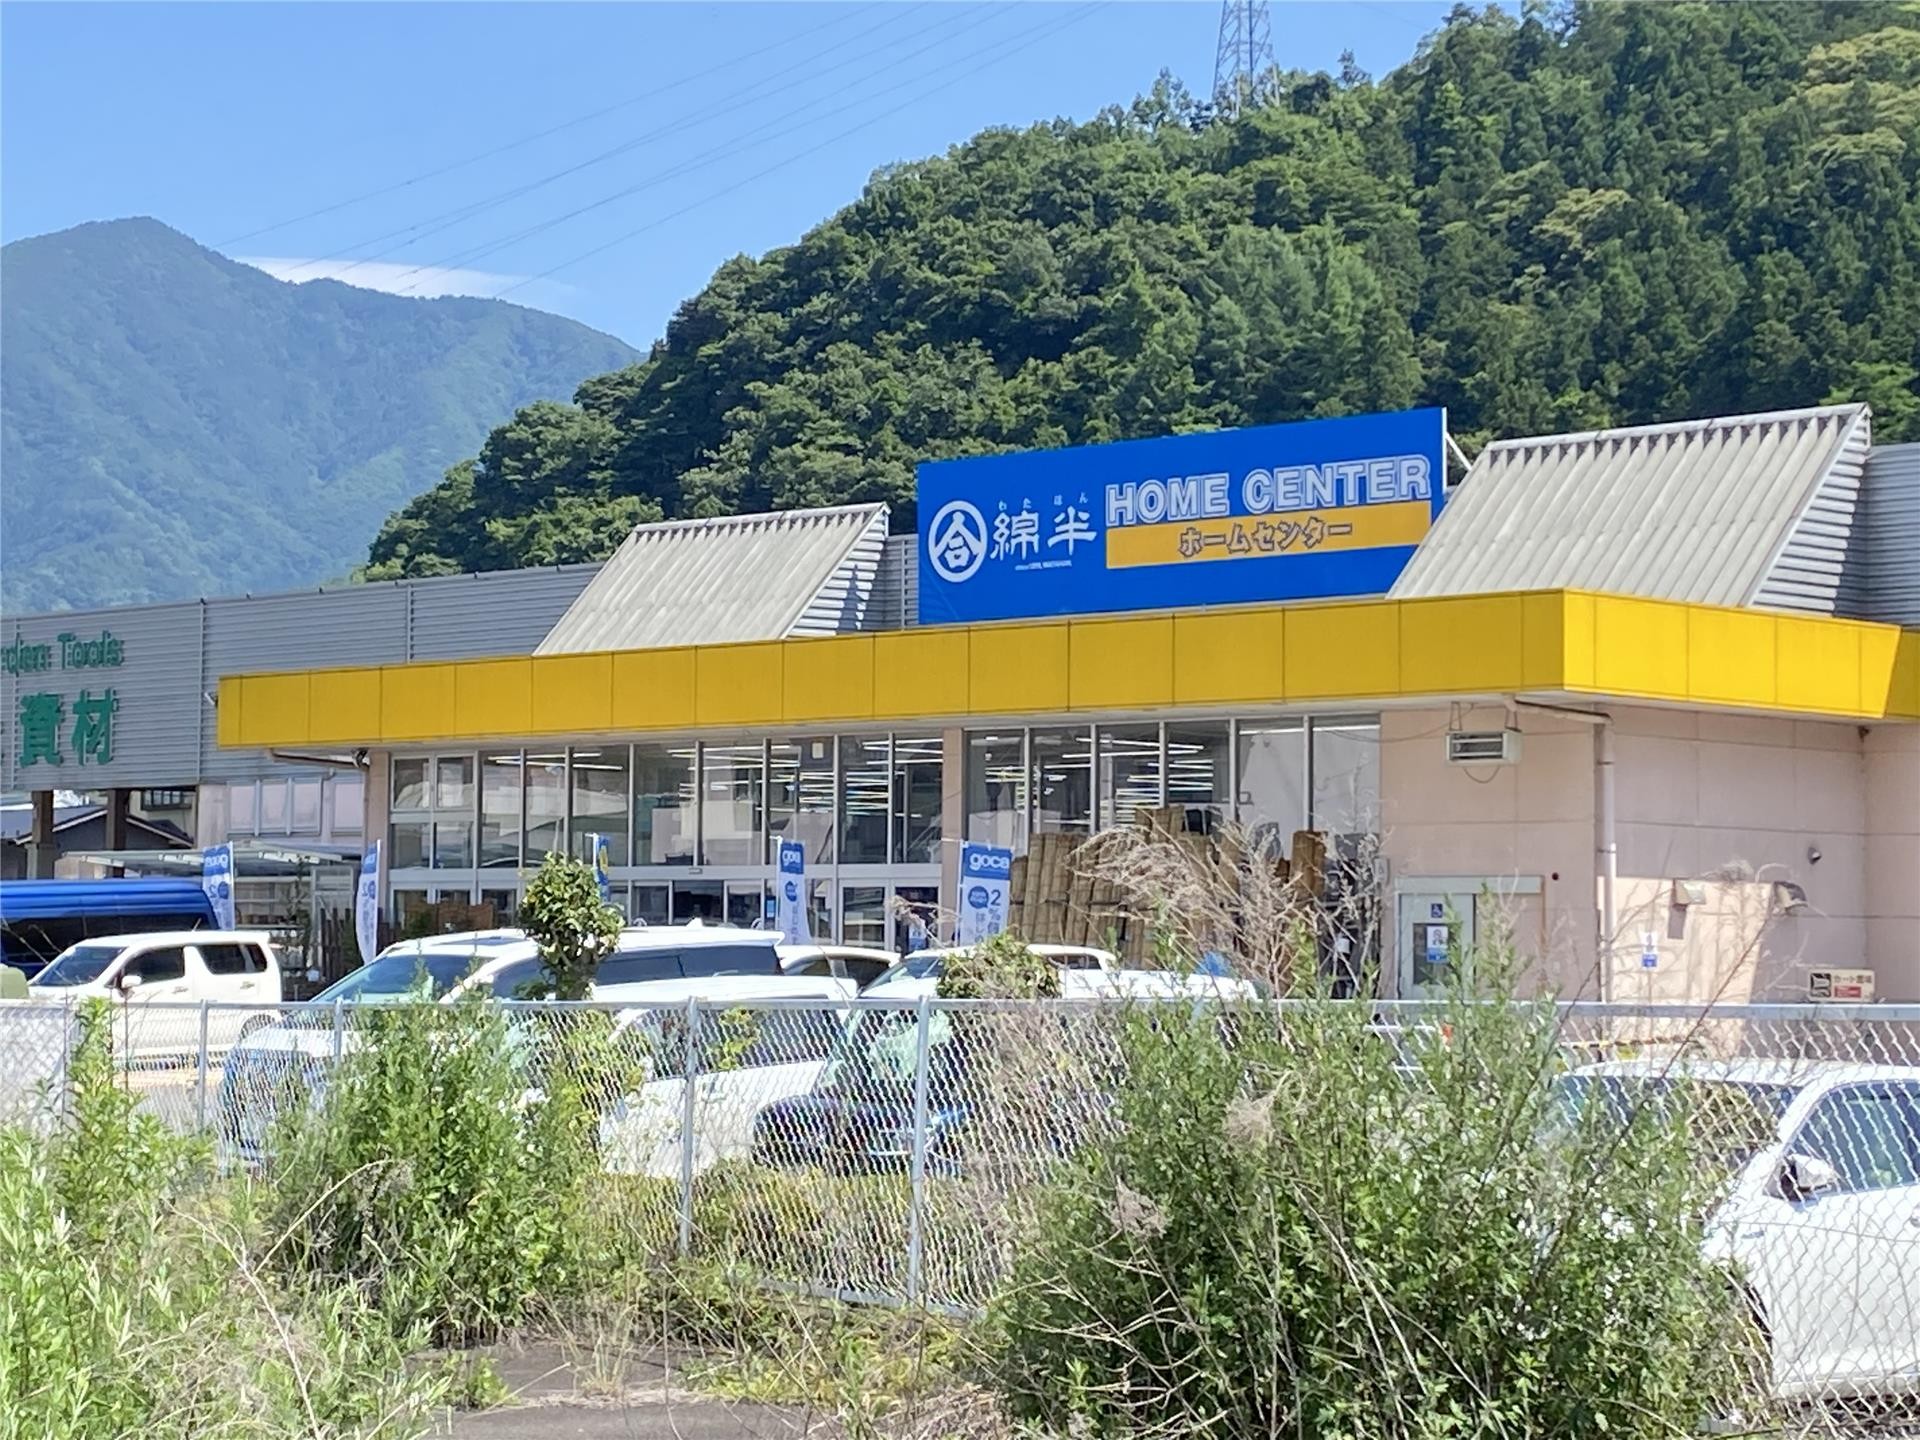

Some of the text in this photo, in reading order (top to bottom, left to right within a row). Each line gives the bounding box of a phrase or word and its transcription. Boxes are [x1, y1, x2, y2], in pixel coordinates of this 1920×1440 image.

[1106, 454, 1432, 526] HOME CENTER
[989, 505, 1098, 561] 綿半
[1177, 517, 1353, 558] ホームセンター
[0, 630, 125, 674] den Tools
[19, 688, 119, 768] 資材
[969, 853, 1010, 871] goca
